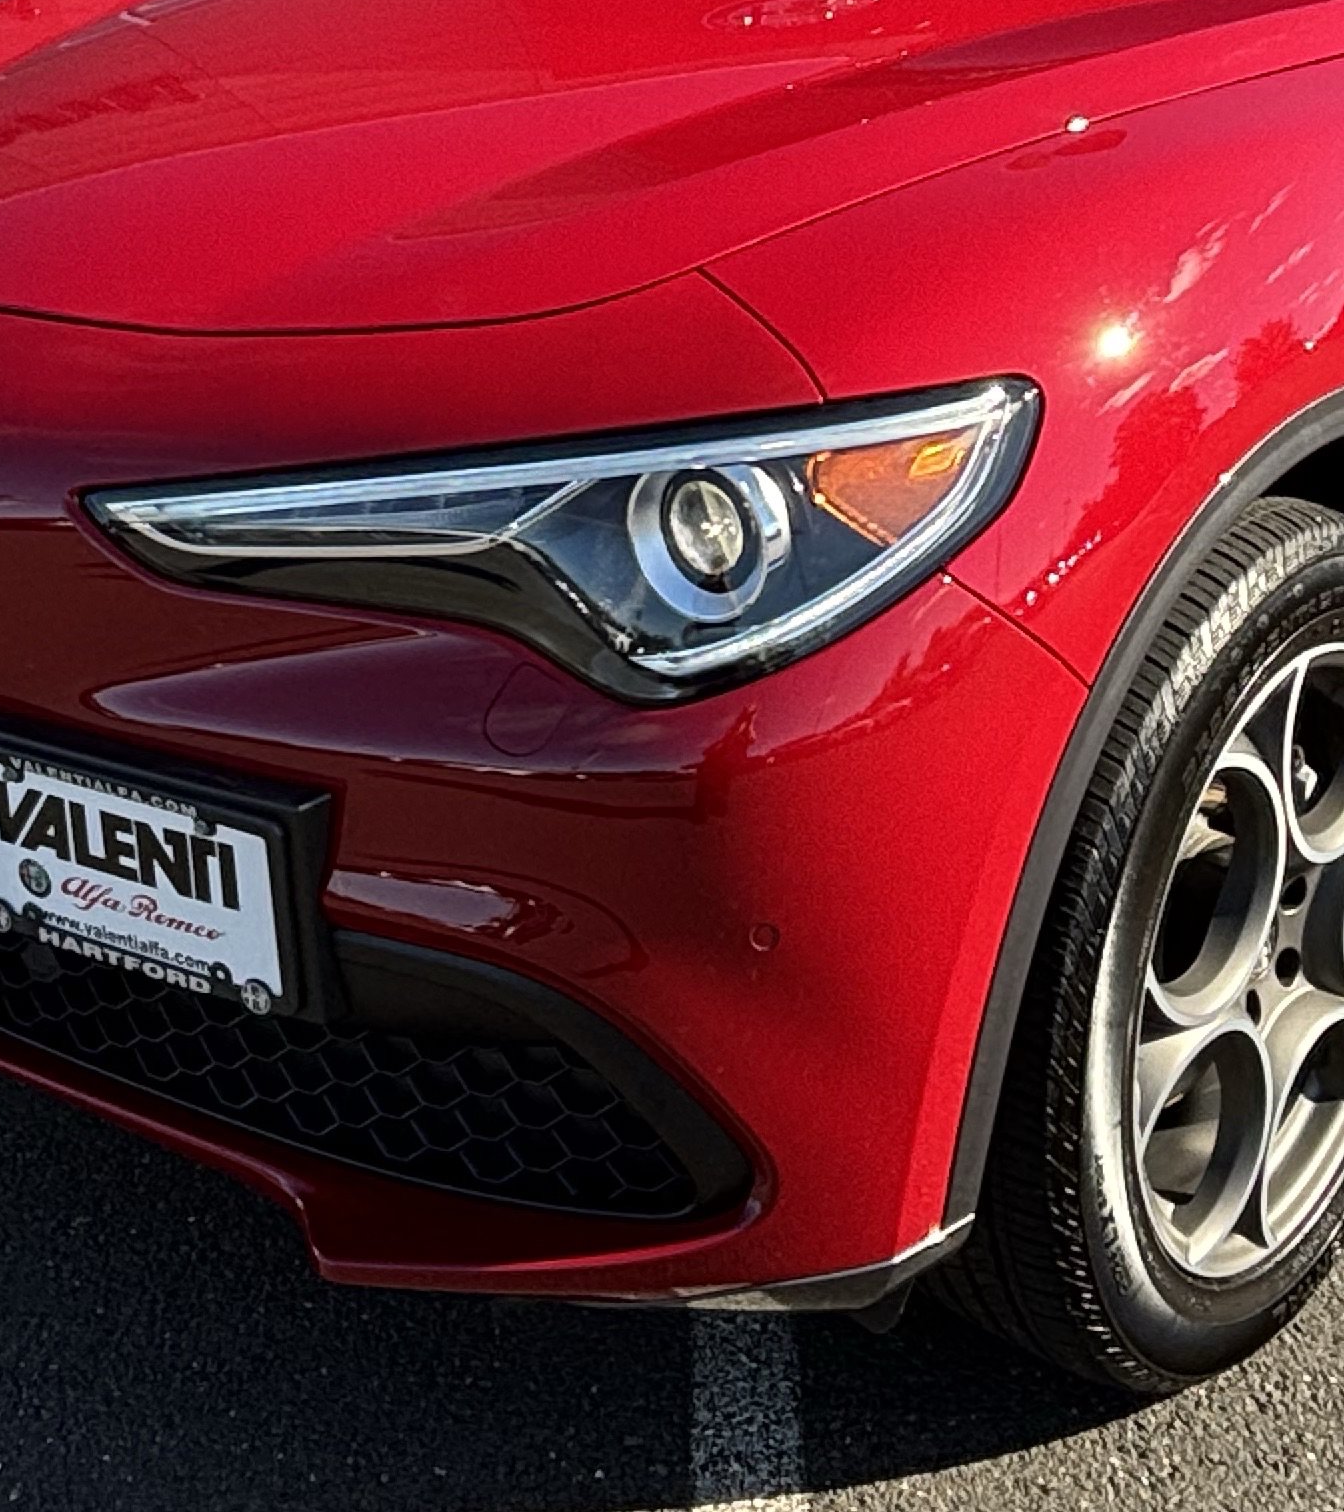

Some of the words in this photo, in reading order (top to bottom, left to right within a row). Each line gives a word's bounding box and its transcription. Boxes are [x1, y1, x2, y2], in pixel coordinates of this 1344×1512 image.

[60, 877, 122, 911] Alfa
[128, 894, 225, 942] Romeo
[38, 926, 212, 994] HARTFORD
